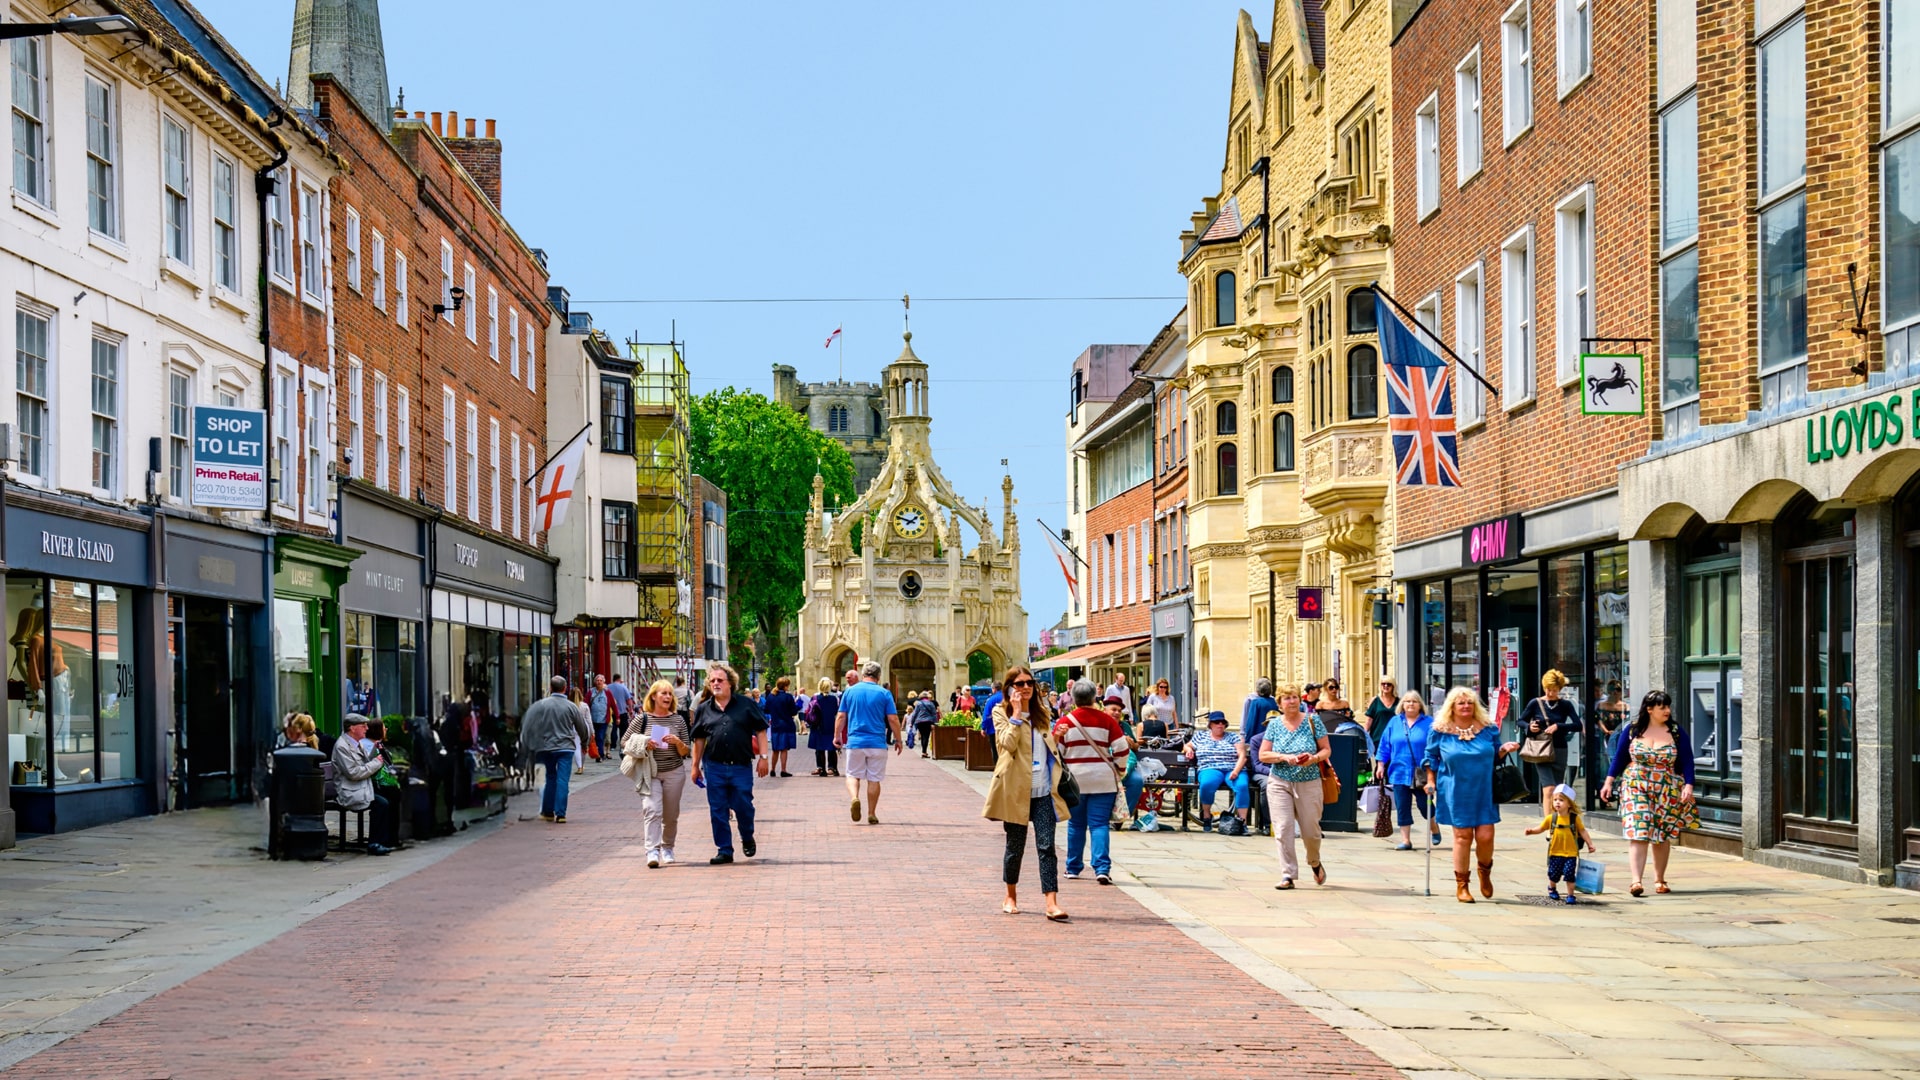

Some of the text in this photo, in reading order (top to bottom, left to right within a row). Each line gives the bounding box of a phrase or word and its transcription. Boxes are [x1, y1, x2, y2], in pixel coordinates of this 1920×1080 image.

[207, 416, 252, 434] SHOP
[1807, 395, 1904, 464] LLOYDS
[198, 437, 260, 457] TO LET
[196, 467, 262, 482] Prime Retail.
[195, 483, 262, 497] 020 7016 5340
[42, 530, 115, 563] RIVER ISLAND
[1480, 519, 1508, 562] HMV
[366, 570, 404, 593] MINT VELVET
